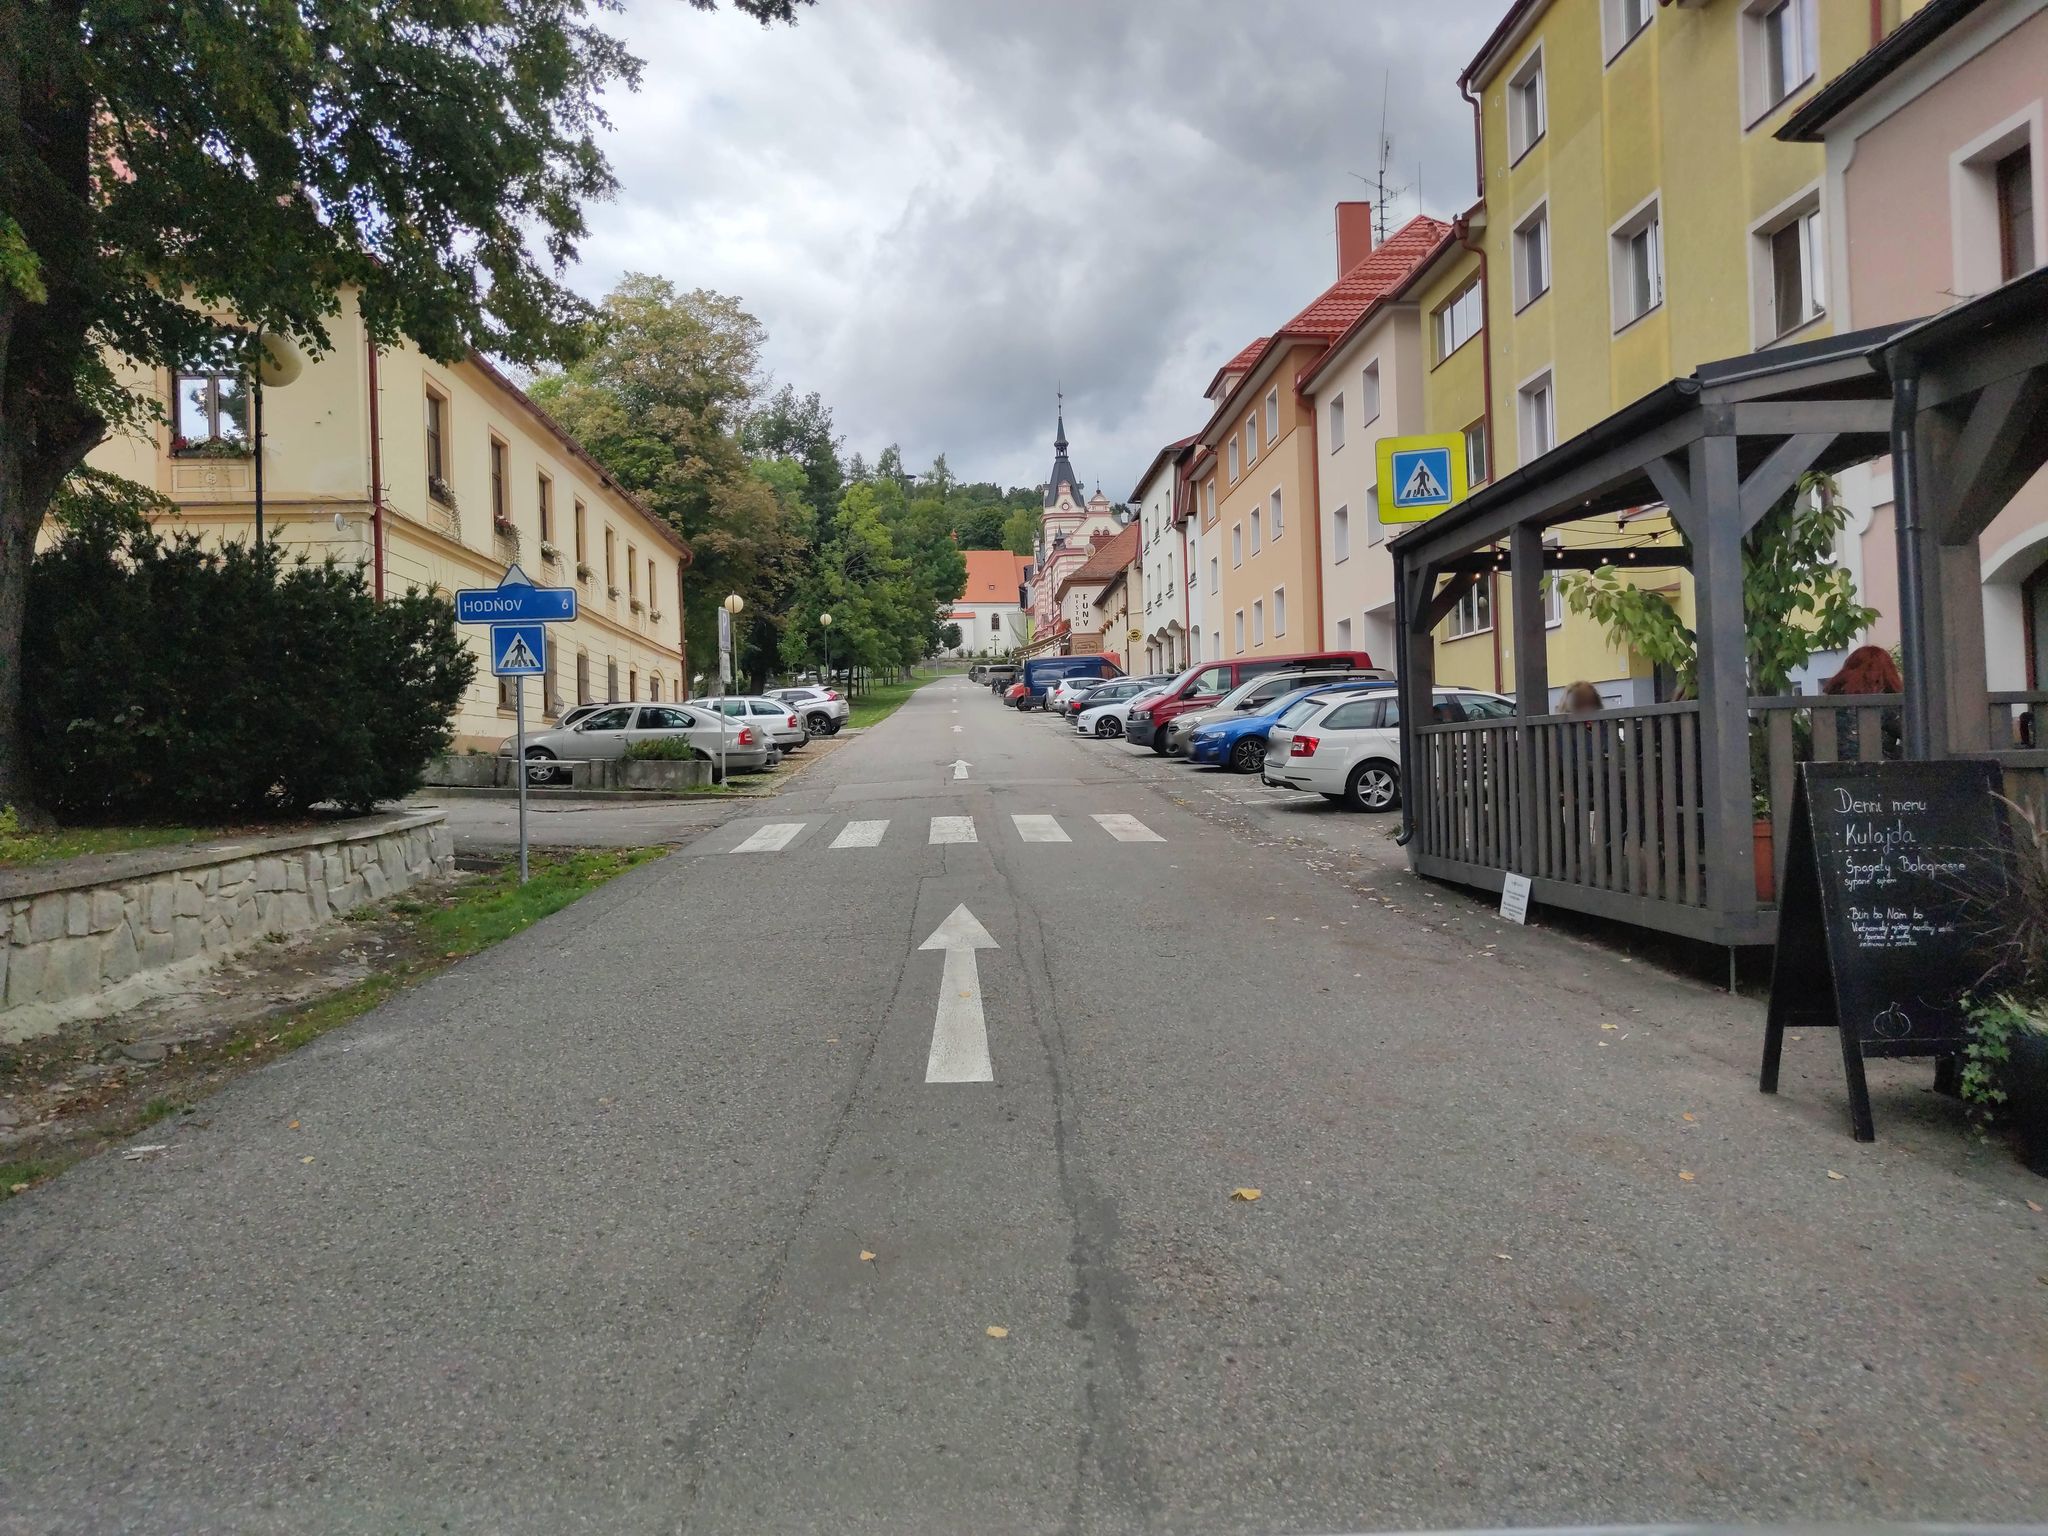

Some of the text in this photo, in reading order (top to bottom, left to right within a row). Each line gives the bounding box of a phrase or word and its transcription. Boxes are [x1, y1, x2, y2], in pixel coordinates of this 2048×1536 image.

[464, 597, 569, 612] HODŇOV 6
[1892, 800, 1927, 811] menu
[1846, 819, 1916, 855] Kulajda
[1913, 906, 1924, 919] bo
